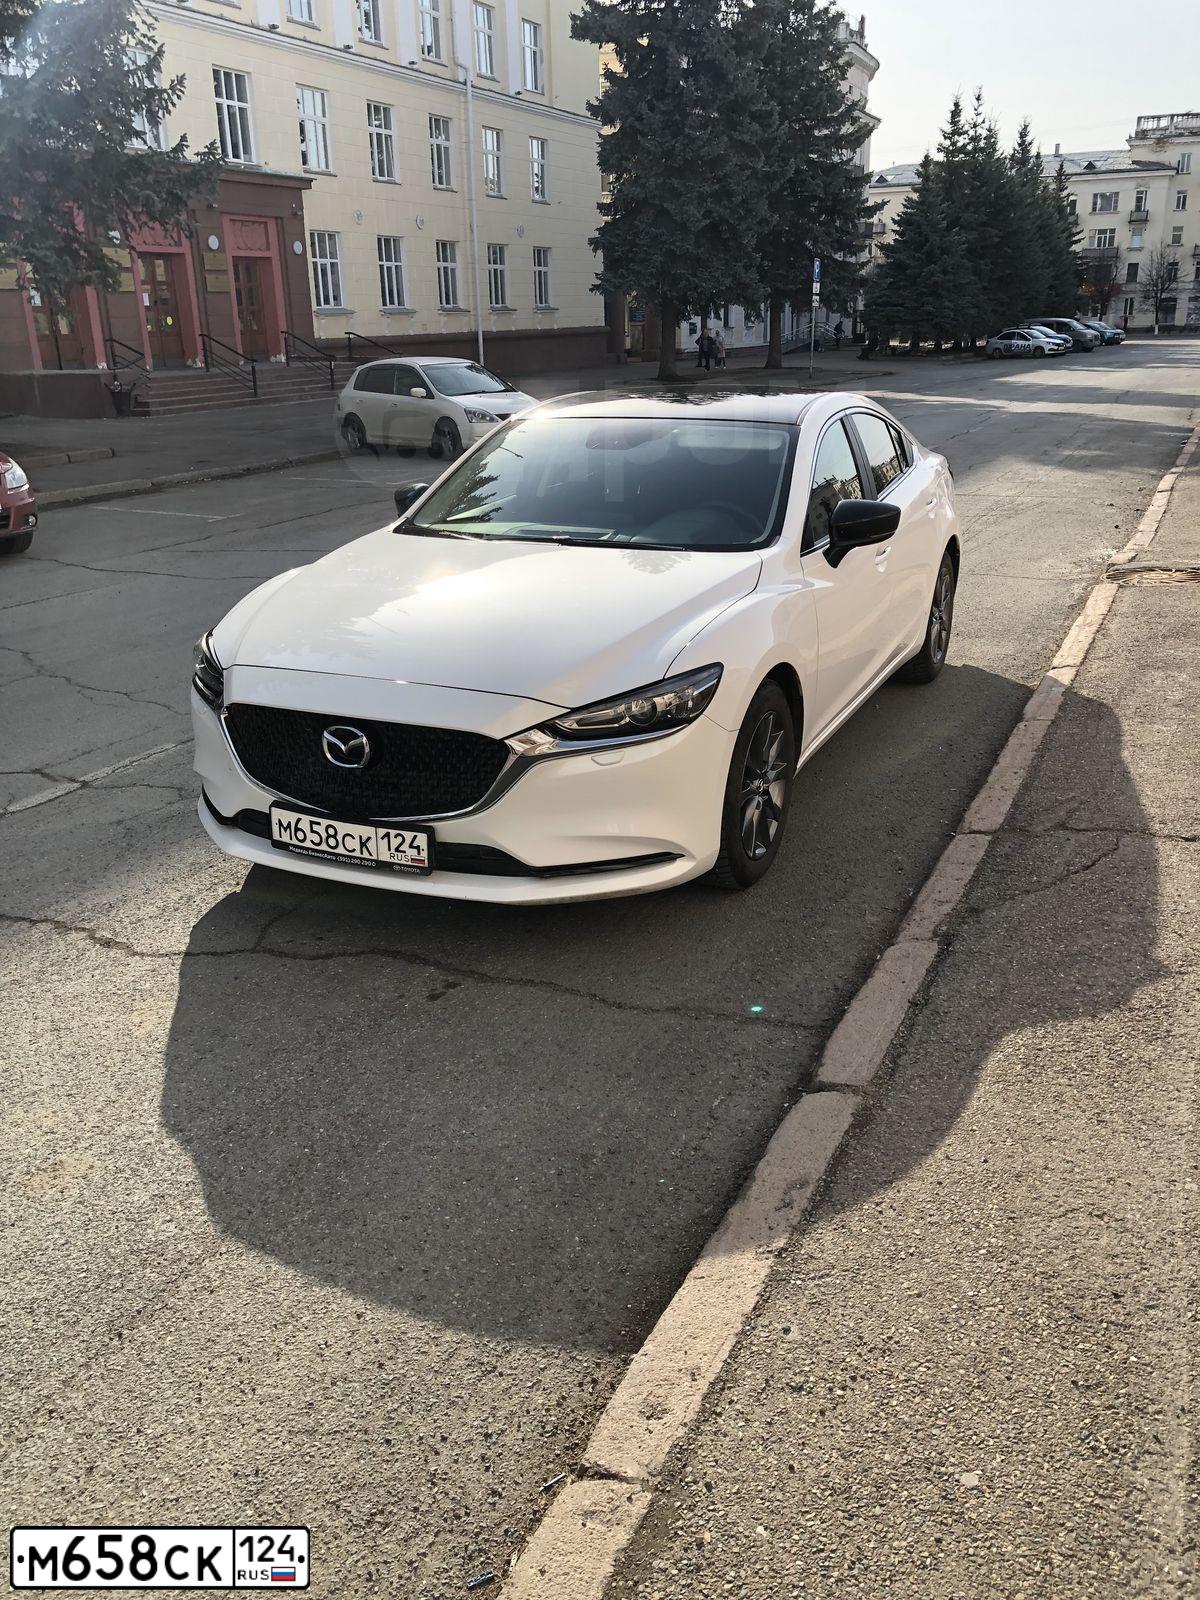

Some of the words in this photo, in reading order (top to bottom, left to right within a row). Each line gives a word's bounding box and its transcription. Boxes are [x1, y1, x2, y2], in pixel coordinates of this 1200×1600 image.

[278, 817, 374, 857] М658СК
[380, 831, 421, 856] 124
[389, 852, 410, 863] RUS
